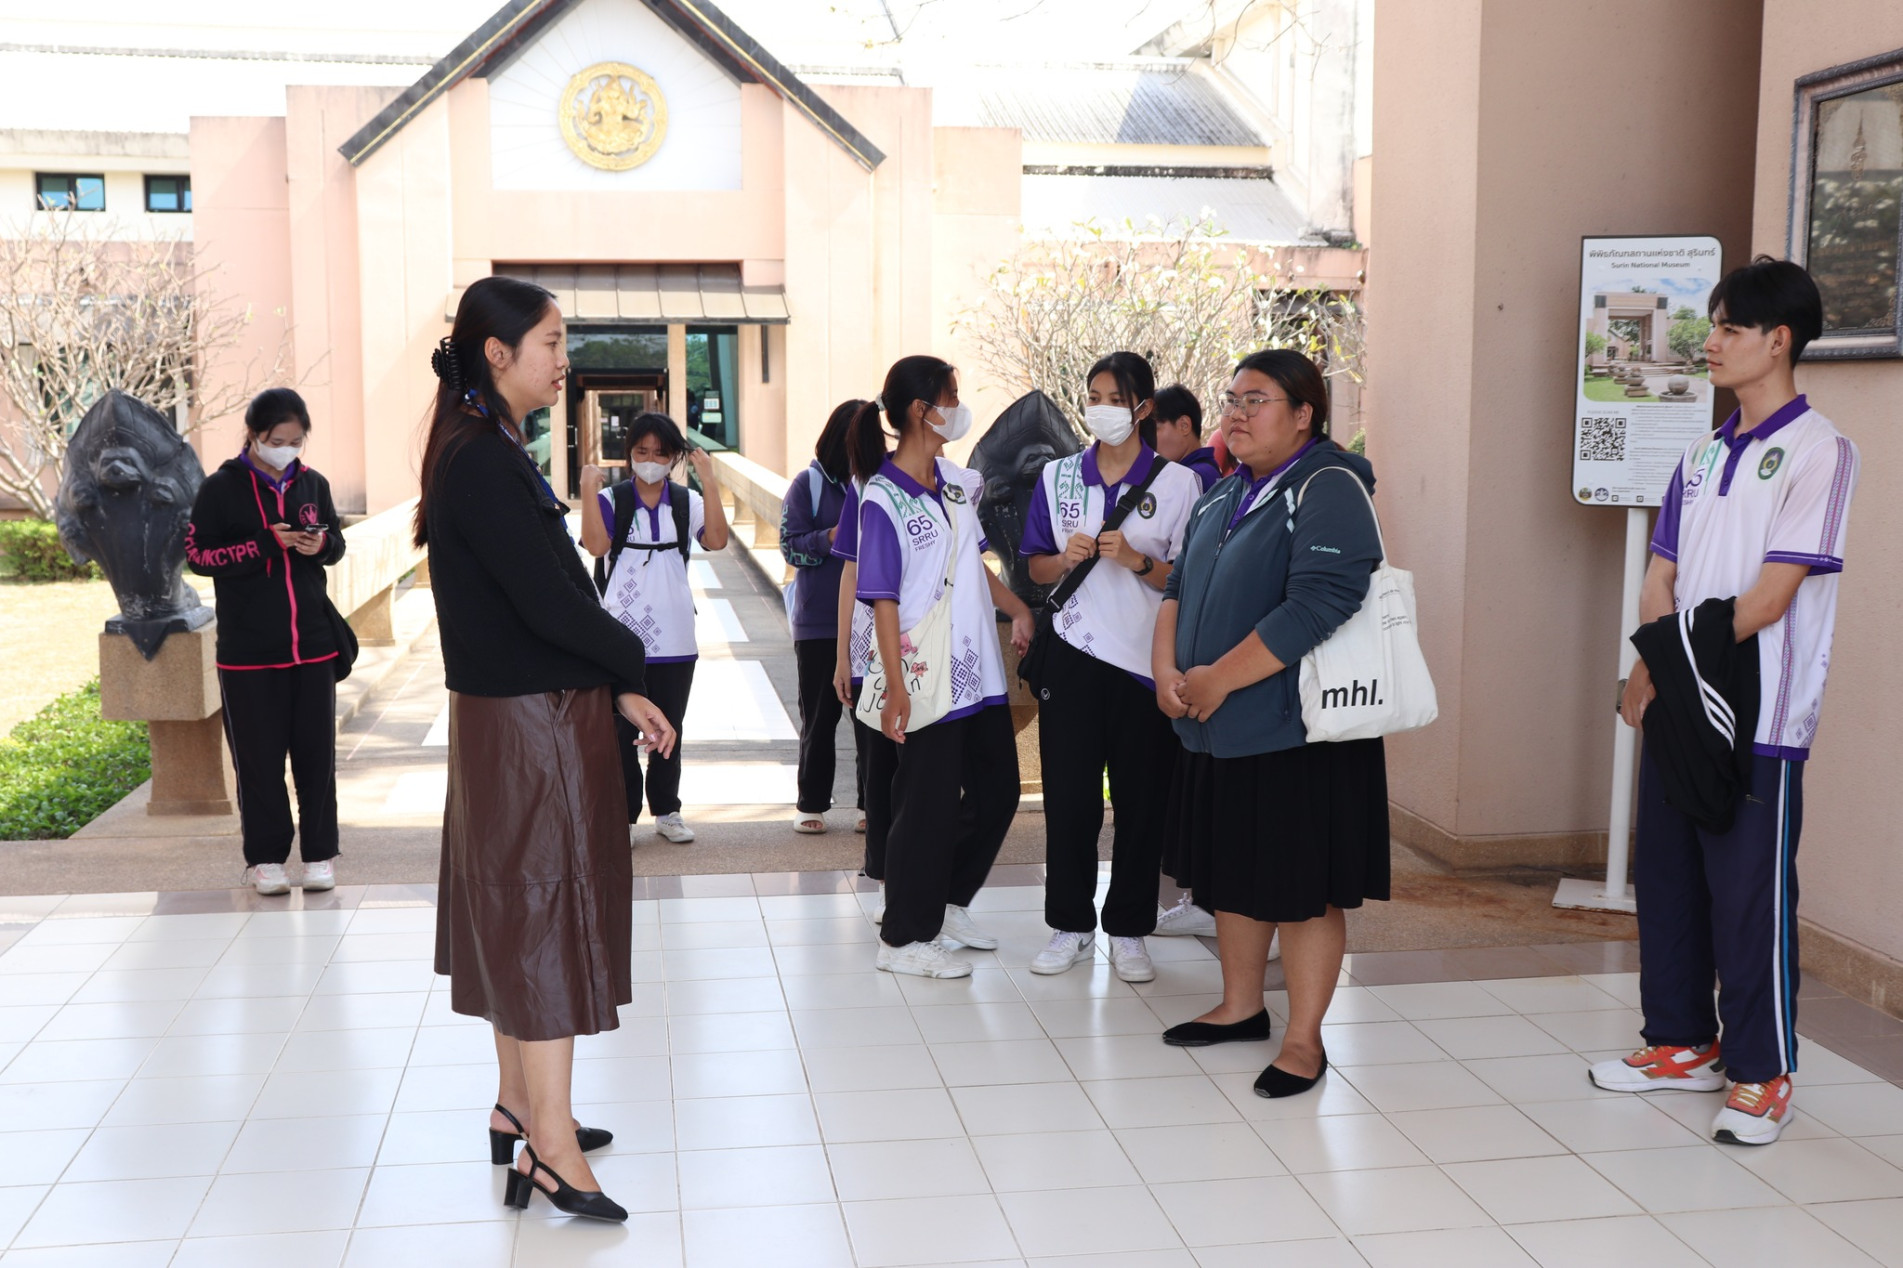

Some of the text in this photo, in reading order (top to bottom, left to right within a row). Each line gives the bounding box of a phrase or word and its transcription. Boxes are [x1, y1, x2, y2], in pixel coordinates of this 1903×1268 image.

[1060, 501, 1080, 519] 65
[906, 515, 933, 536] 65
[912, 529, 939, 546] SRRU
[1316, 545, 1341, 554] Columbia
[1321, 679, 1384, 710] mhl.
